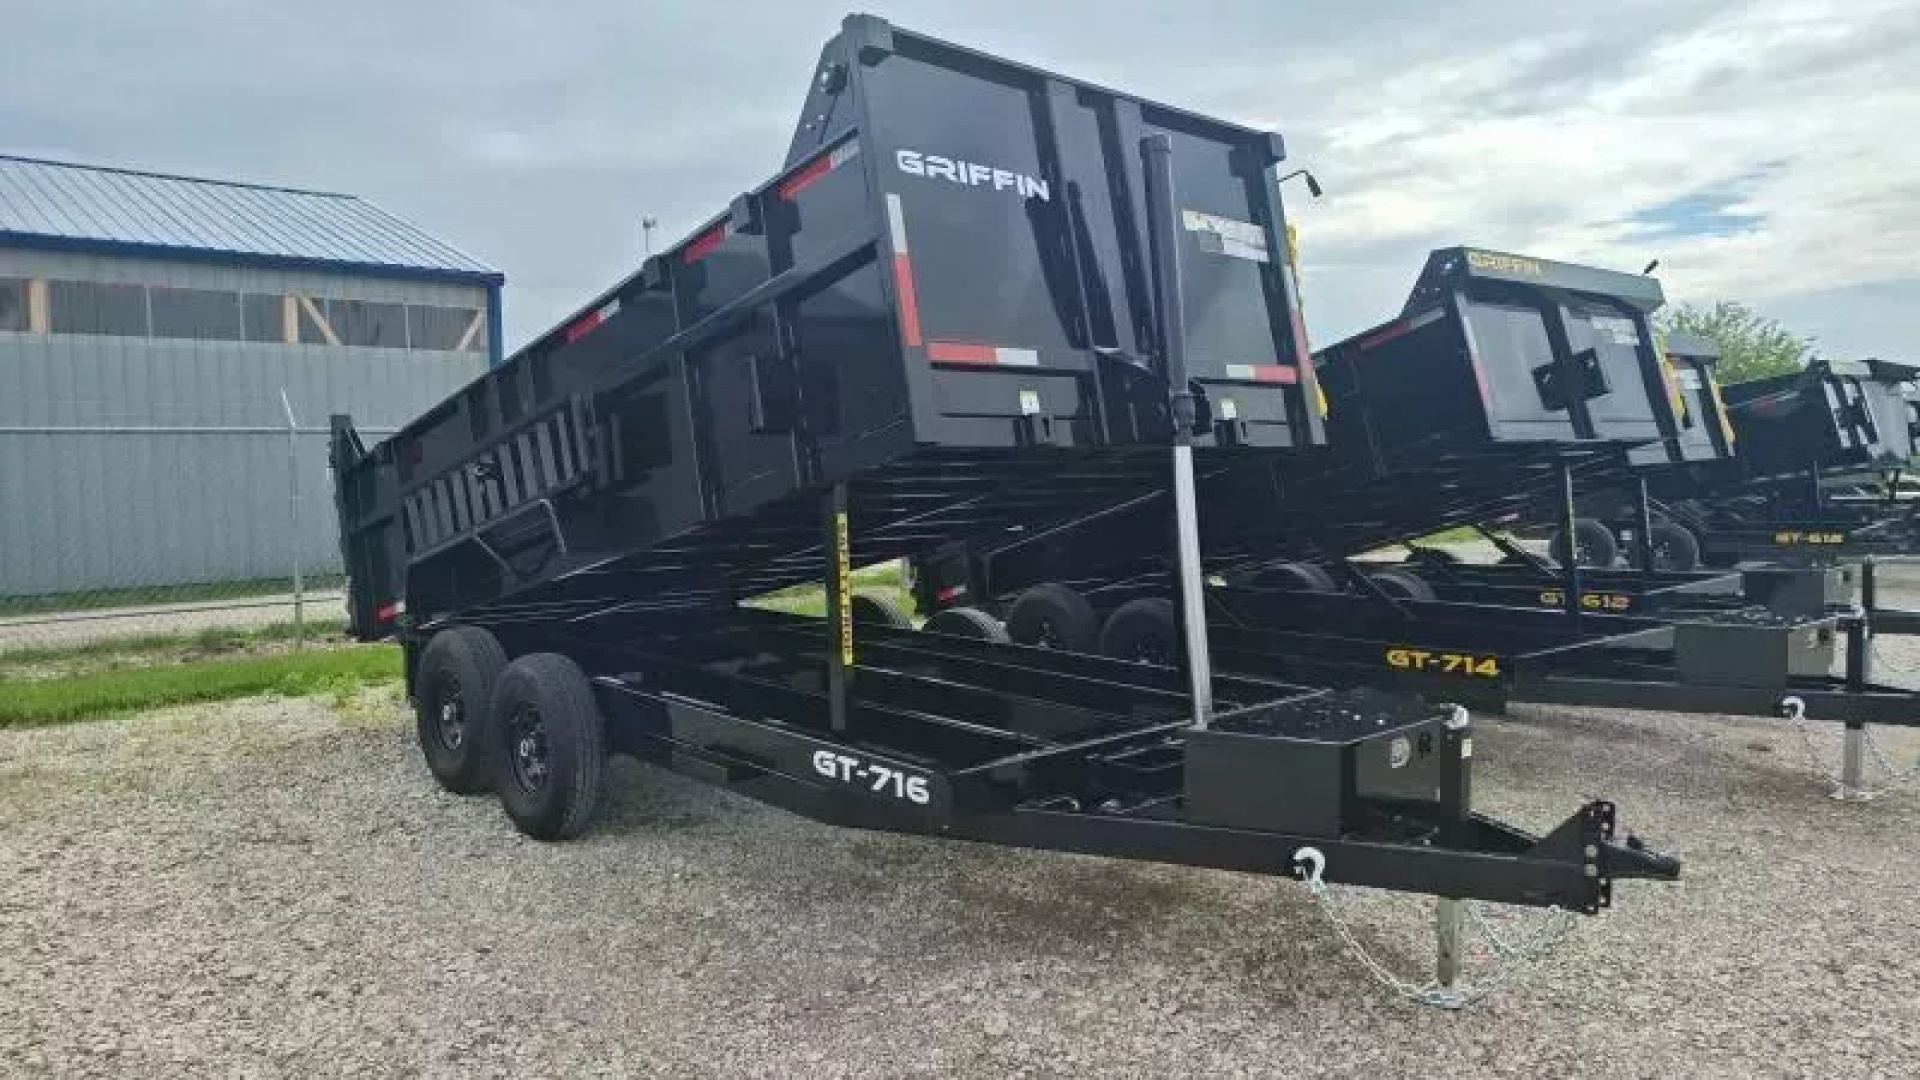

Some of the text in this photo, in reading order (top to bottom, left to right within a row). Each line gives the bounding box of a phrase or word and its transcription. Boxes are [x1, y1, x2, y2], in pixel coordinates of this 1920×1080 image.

[897, 149, 1050, 202] GRIFFIN
[1386, 650, 1499, 675] GT-714
[813, 751, 930, 805] GT-716
